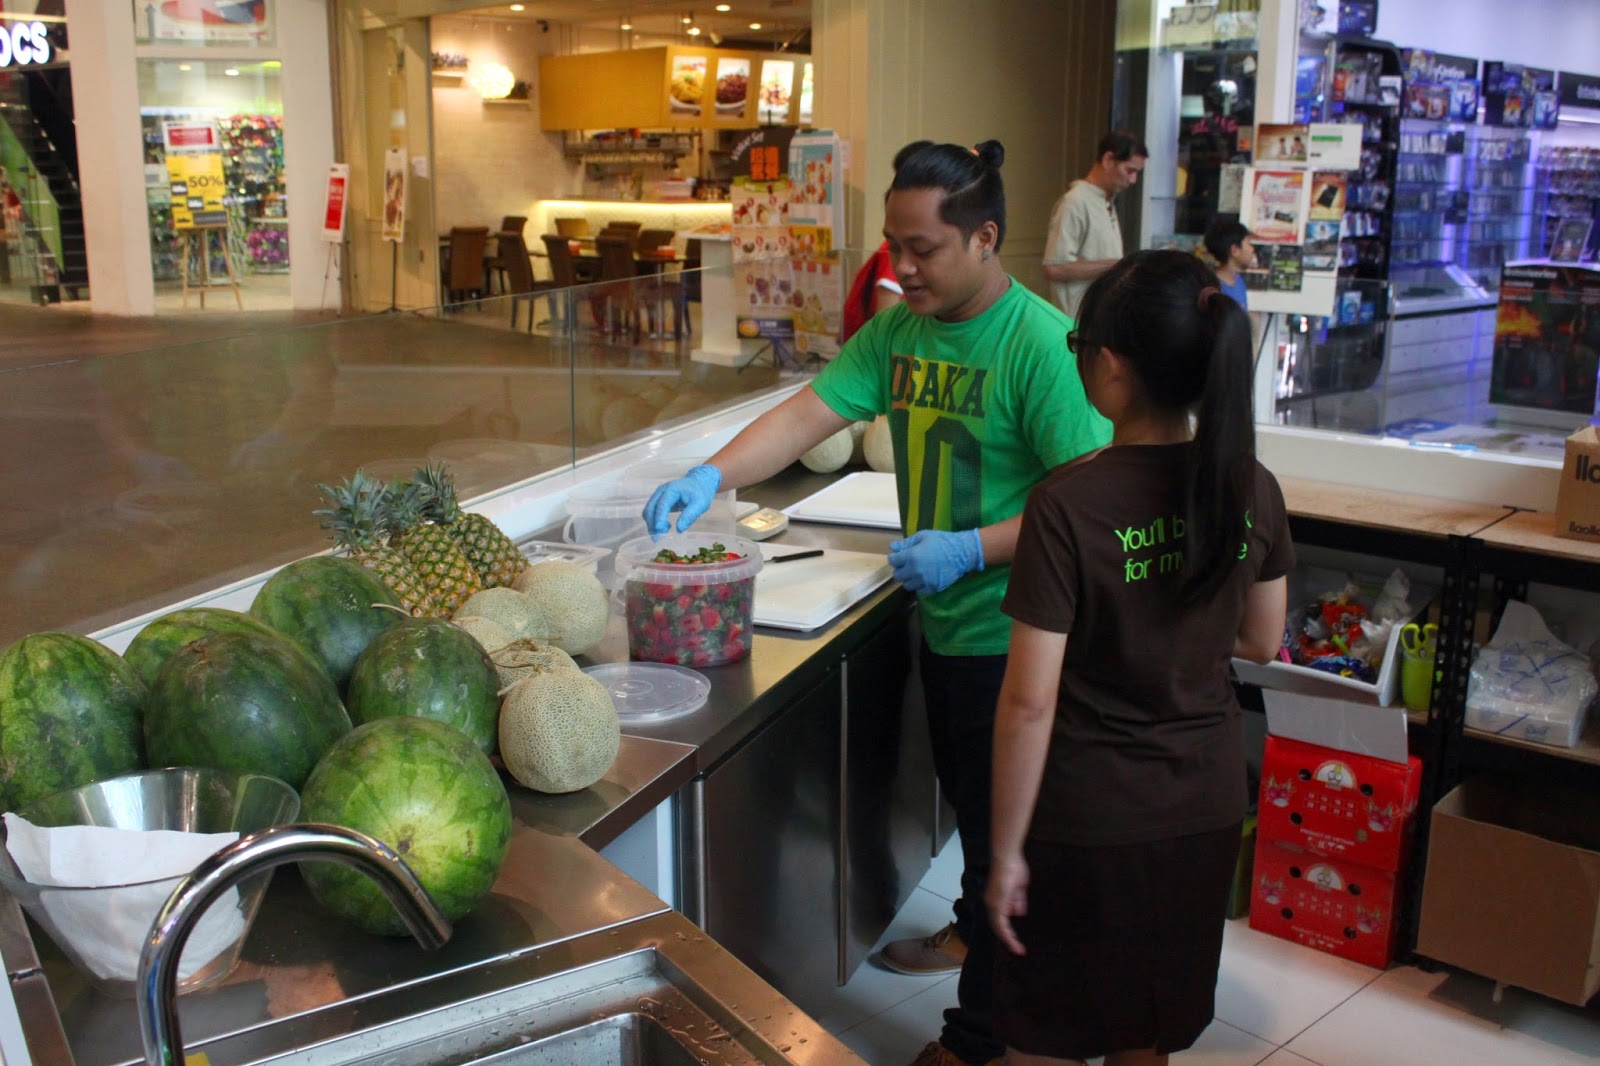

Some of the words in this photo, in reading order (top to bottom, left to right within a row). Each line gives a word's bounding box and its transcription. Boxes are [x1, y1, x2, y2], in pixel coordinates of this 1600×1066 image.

[189, 175, 223, 188] 50%
[890, 357, 987, 417] OSAKA
[1114, 517, 1165, 552] You'll
[1124, 558, 1152, 582] for
